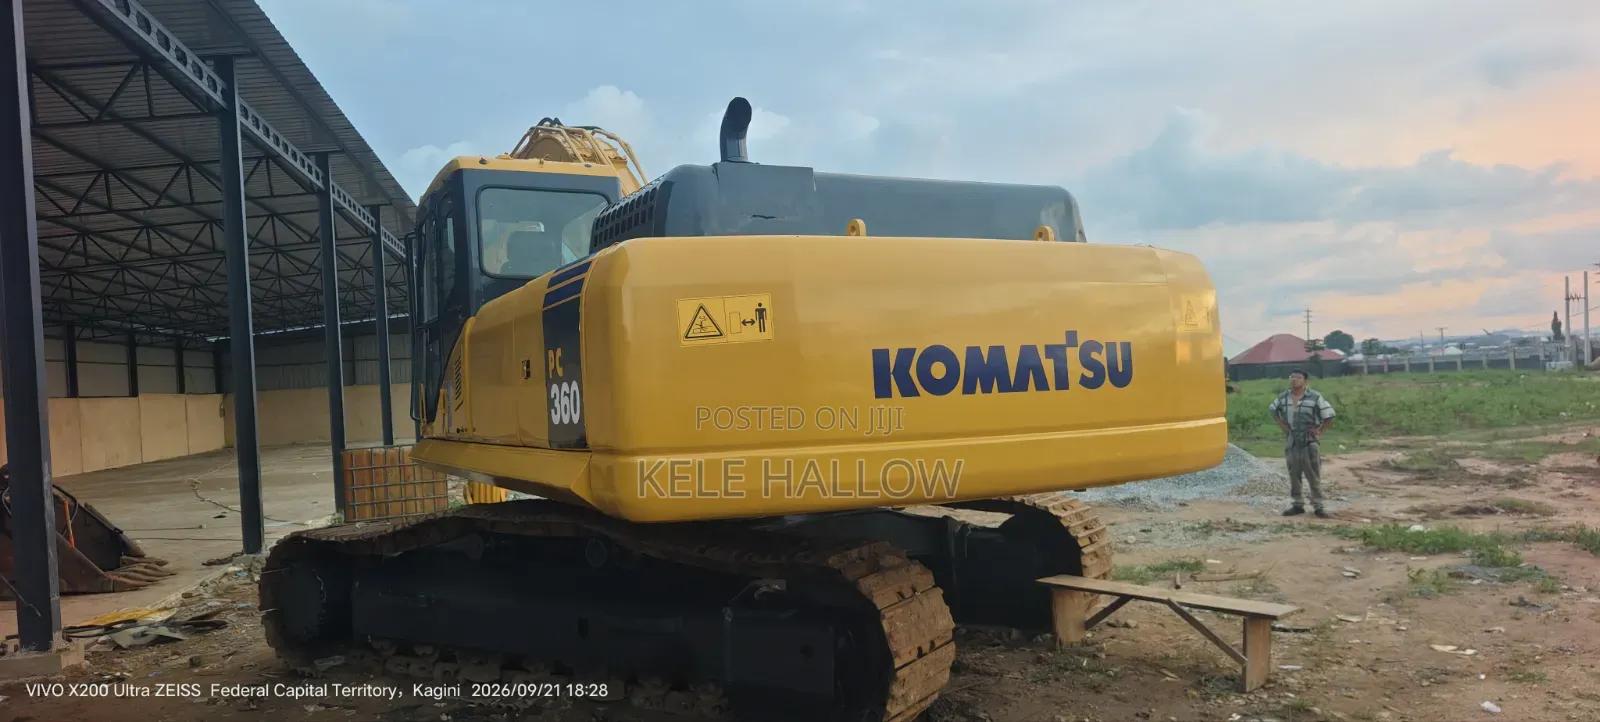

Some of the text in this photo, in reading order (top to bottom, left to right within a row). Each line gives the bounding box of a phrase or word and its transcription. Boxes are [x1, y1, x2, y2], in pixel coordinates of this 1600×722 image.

[548, 348, 563, 379] PC
[872, 330, 1133, 399] KOMATSU
[551, 381, 580, 425] 360
